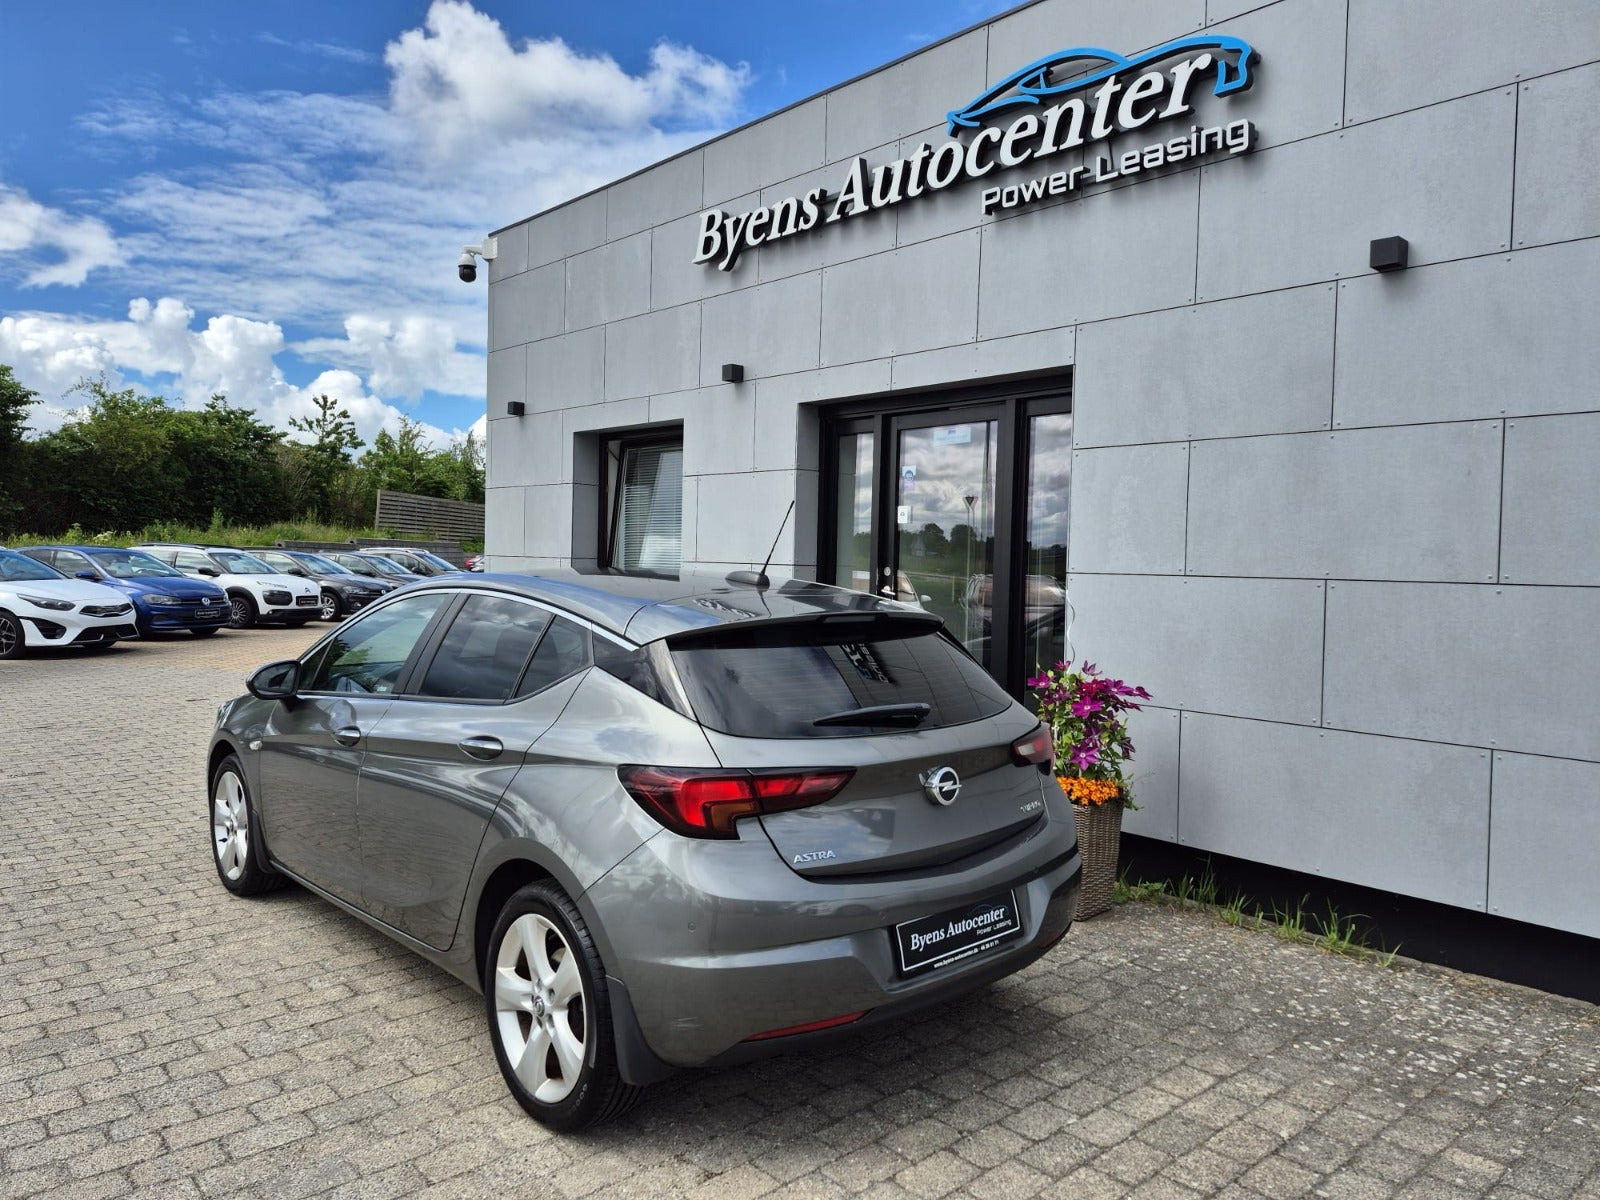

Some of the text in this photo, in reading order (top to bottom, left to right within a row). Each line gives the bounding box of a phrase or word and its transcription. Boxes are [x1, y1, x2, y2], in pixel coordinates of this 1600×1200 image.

[692, 53, 1212, 271] Byens Autocenter
[981, 118, 1250, 215] Power Leasing
[793, 850, 836, 863] ASTRA
[911, 907, 1005, 952] Byens Autocenter
